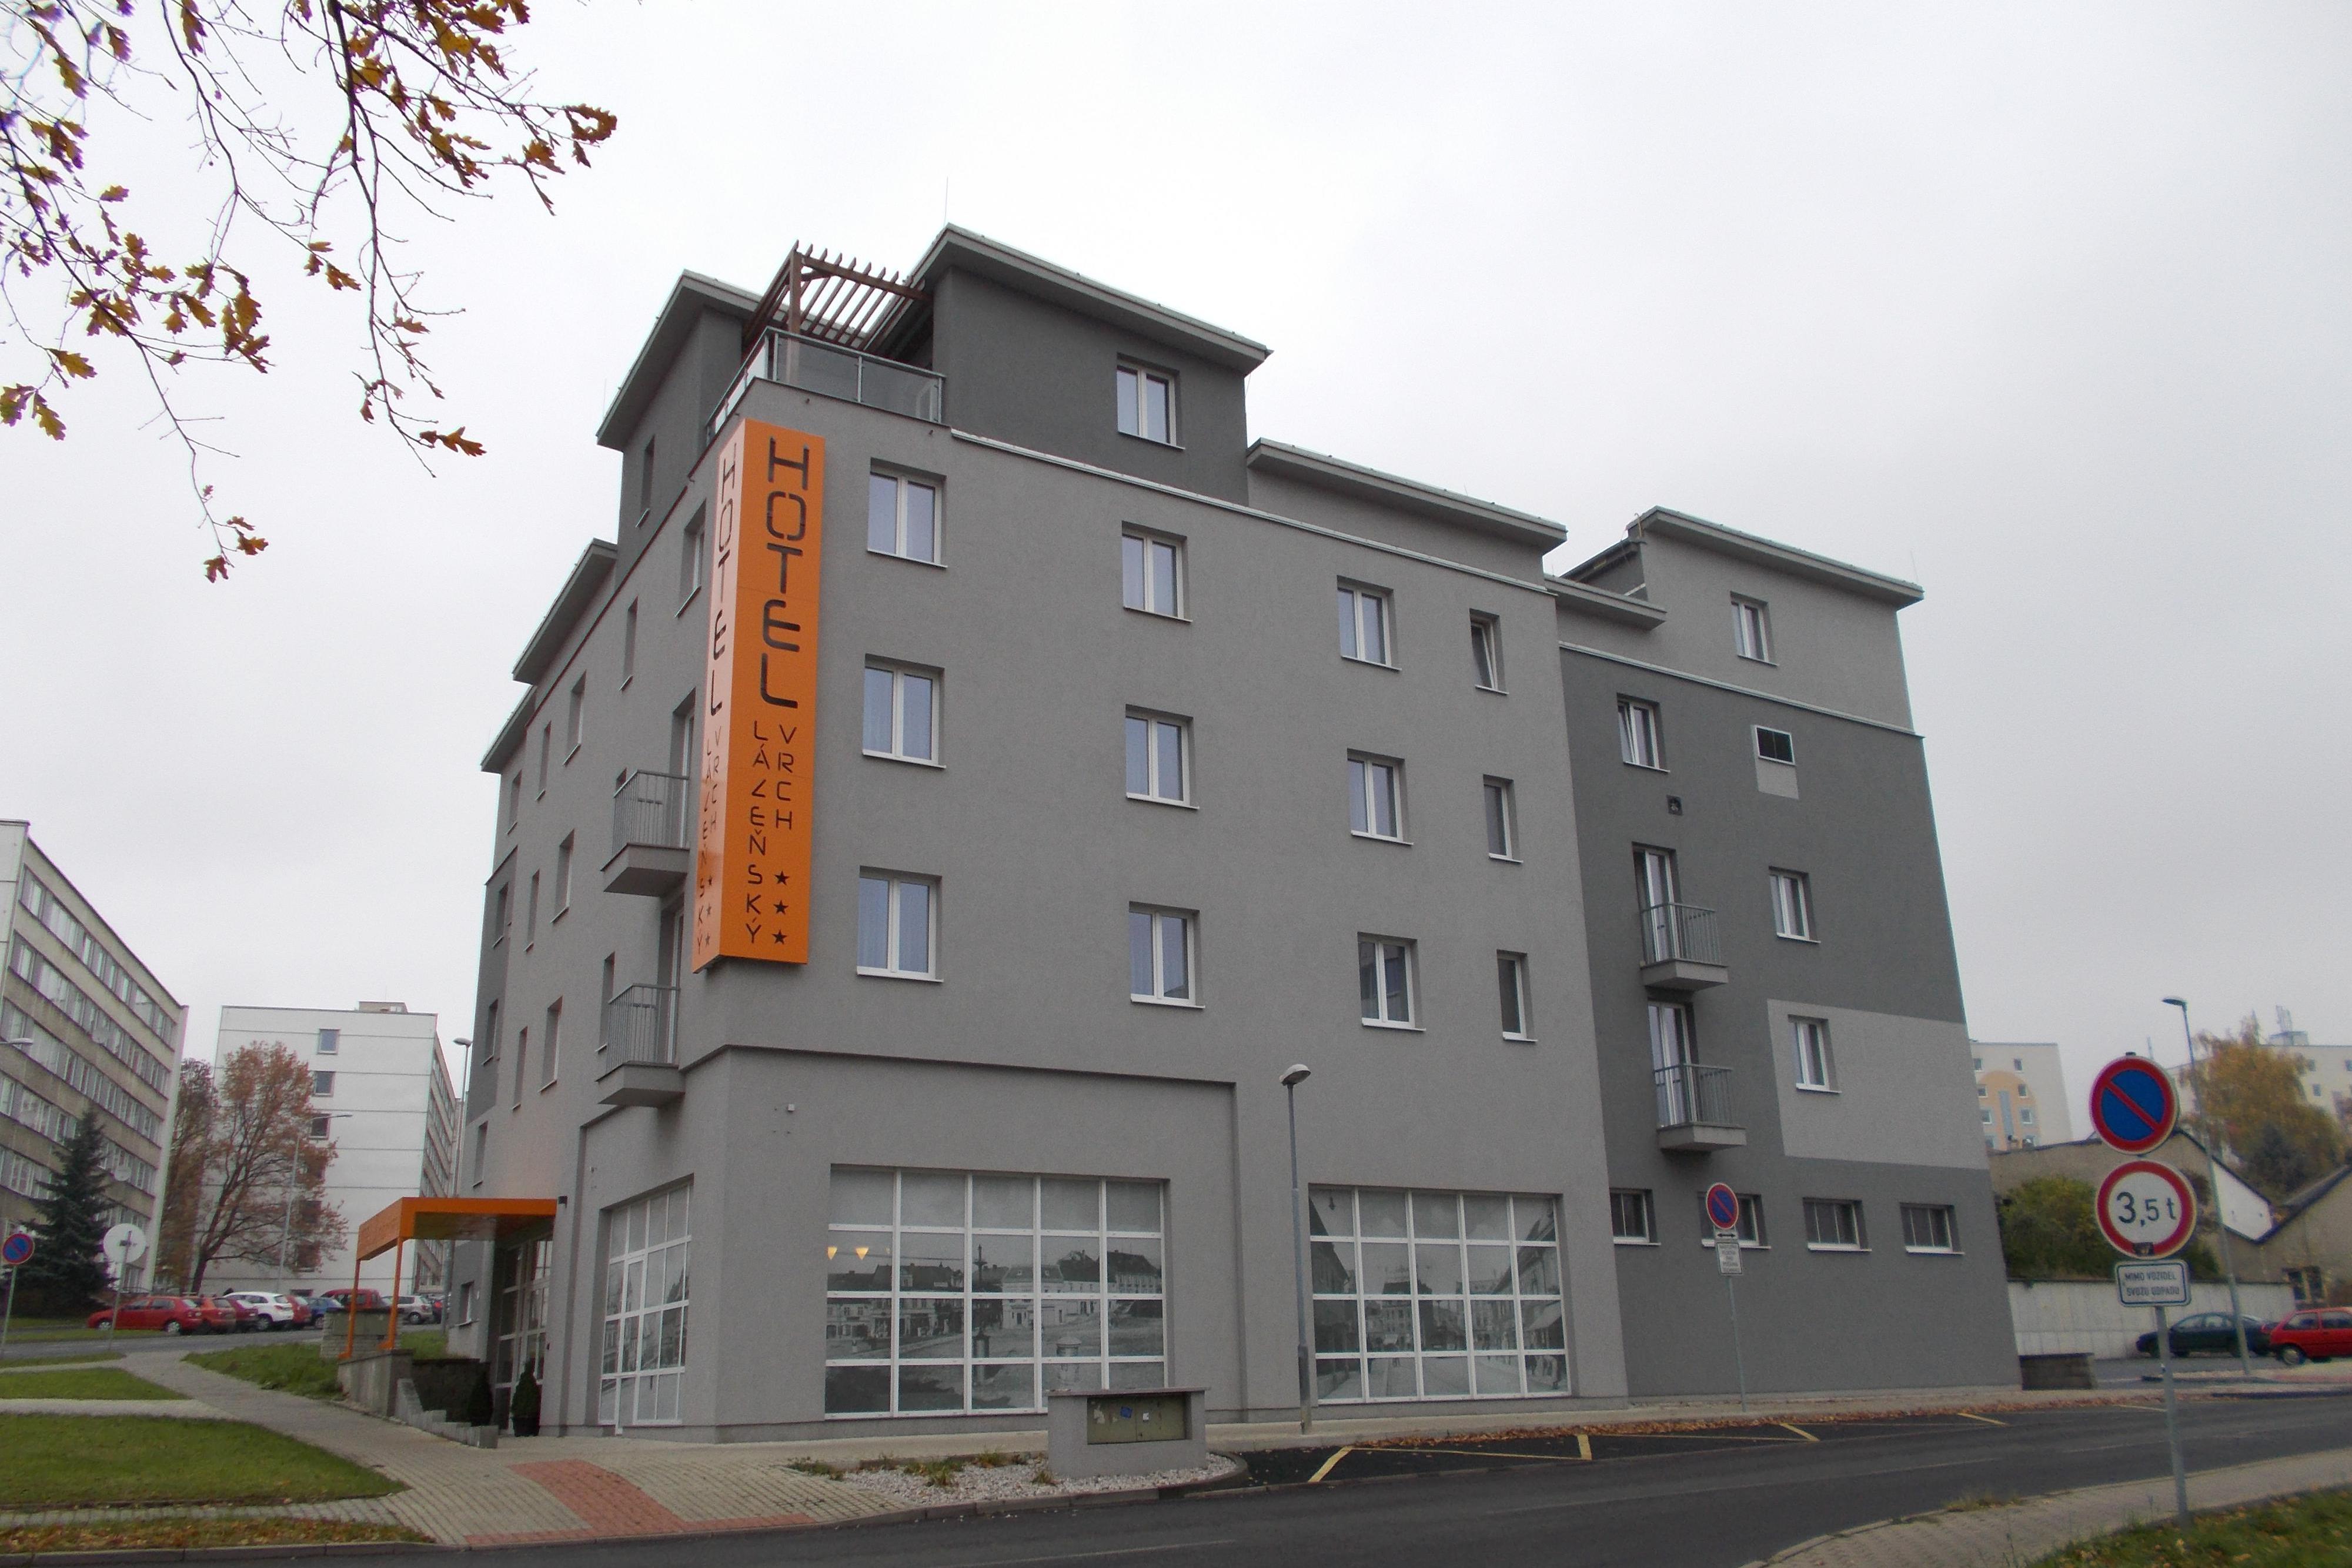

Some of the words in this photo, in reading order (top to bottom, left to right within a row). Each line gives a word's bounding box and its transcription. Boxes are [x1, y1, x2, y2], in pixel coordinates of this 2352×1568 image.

[710, 443, 736, 716] HOTEL
[760, 436, 809, 709] HOTEL
[776, 724, 797, 830] VRCH
[2116, 1191, 2159, 1227] 3,5
[2167, 1198, 2176, 1220] t
